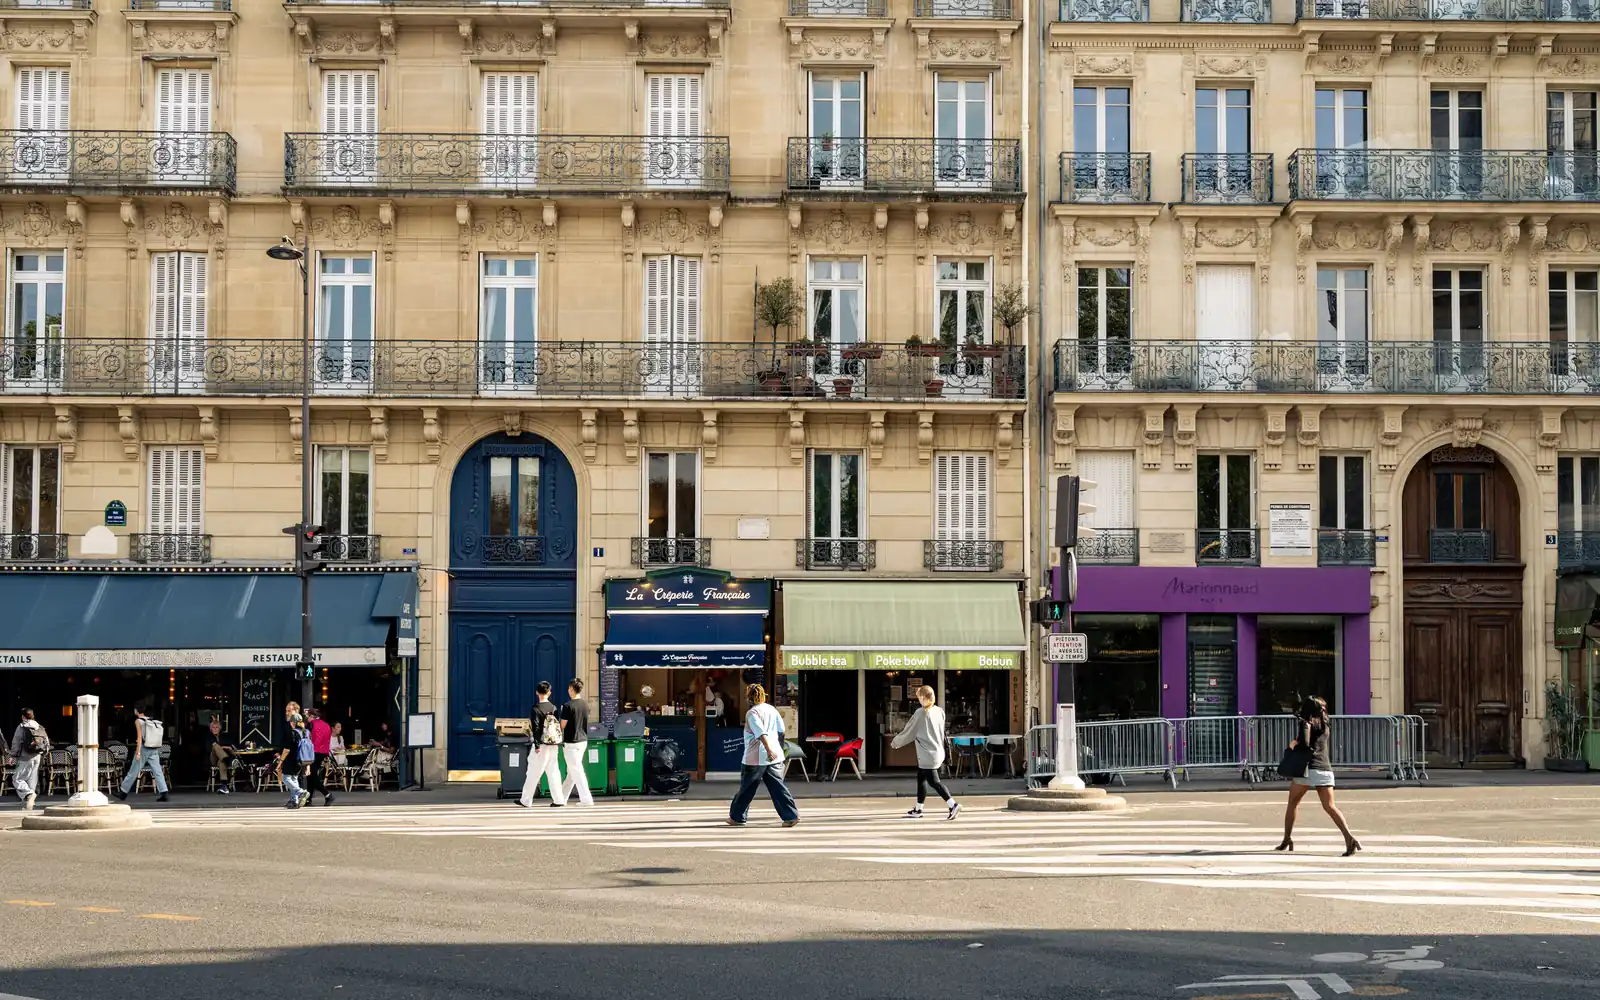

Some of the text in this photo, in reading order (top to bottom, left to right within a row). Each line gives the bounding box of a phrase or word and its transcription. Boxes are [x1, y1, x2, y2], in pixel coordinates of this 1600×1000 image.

[1548, 535, 1554, 544] 3
[1161, 576, 1259, 599] Marionnaud
[625, 587, 751, 602] La Crêperie Française
[75, 651, 214, 666] LE CERCLE LUXEMBOURG
[252, 653, 323, 662] RESTAURNT
[791, 654, 847, 666] Bubble tea
[875, 655, 930, 666] Poke bowl
[979, 655, 1013, 666] Bobun
